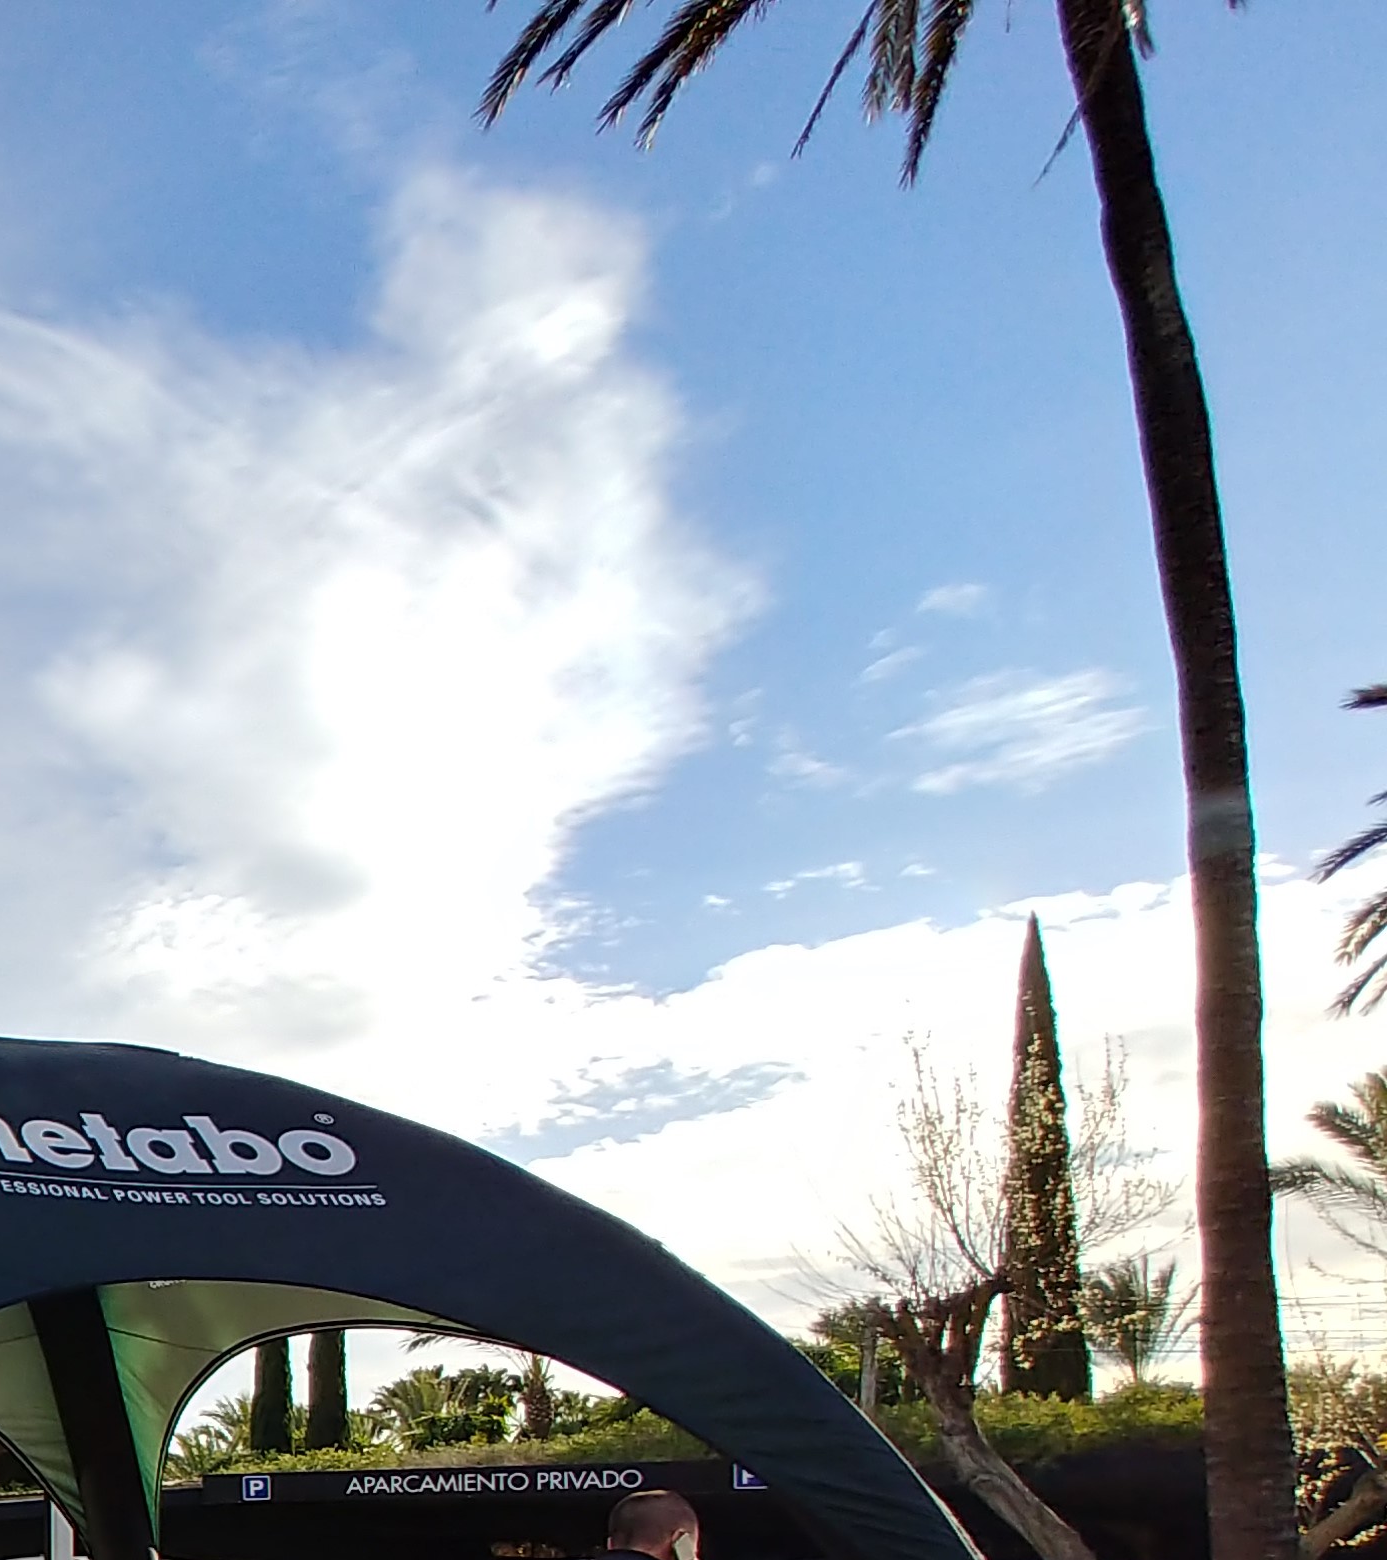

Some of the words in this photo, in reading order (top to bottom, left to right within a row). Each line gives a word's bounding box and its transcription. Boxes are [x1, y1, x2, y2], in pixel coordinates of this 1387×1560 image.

[112, 1188, 190, 1204] POWER
[193, 1192, 252, 1205] TOOL
[256, 1192, 387, 1207] SOLUTIONS
[249, 1480, 264, 1497] P
[345, 1472, 530, 1495] APARCAMIENTO
[536, 1469, 643, 1491] PRIVADO
